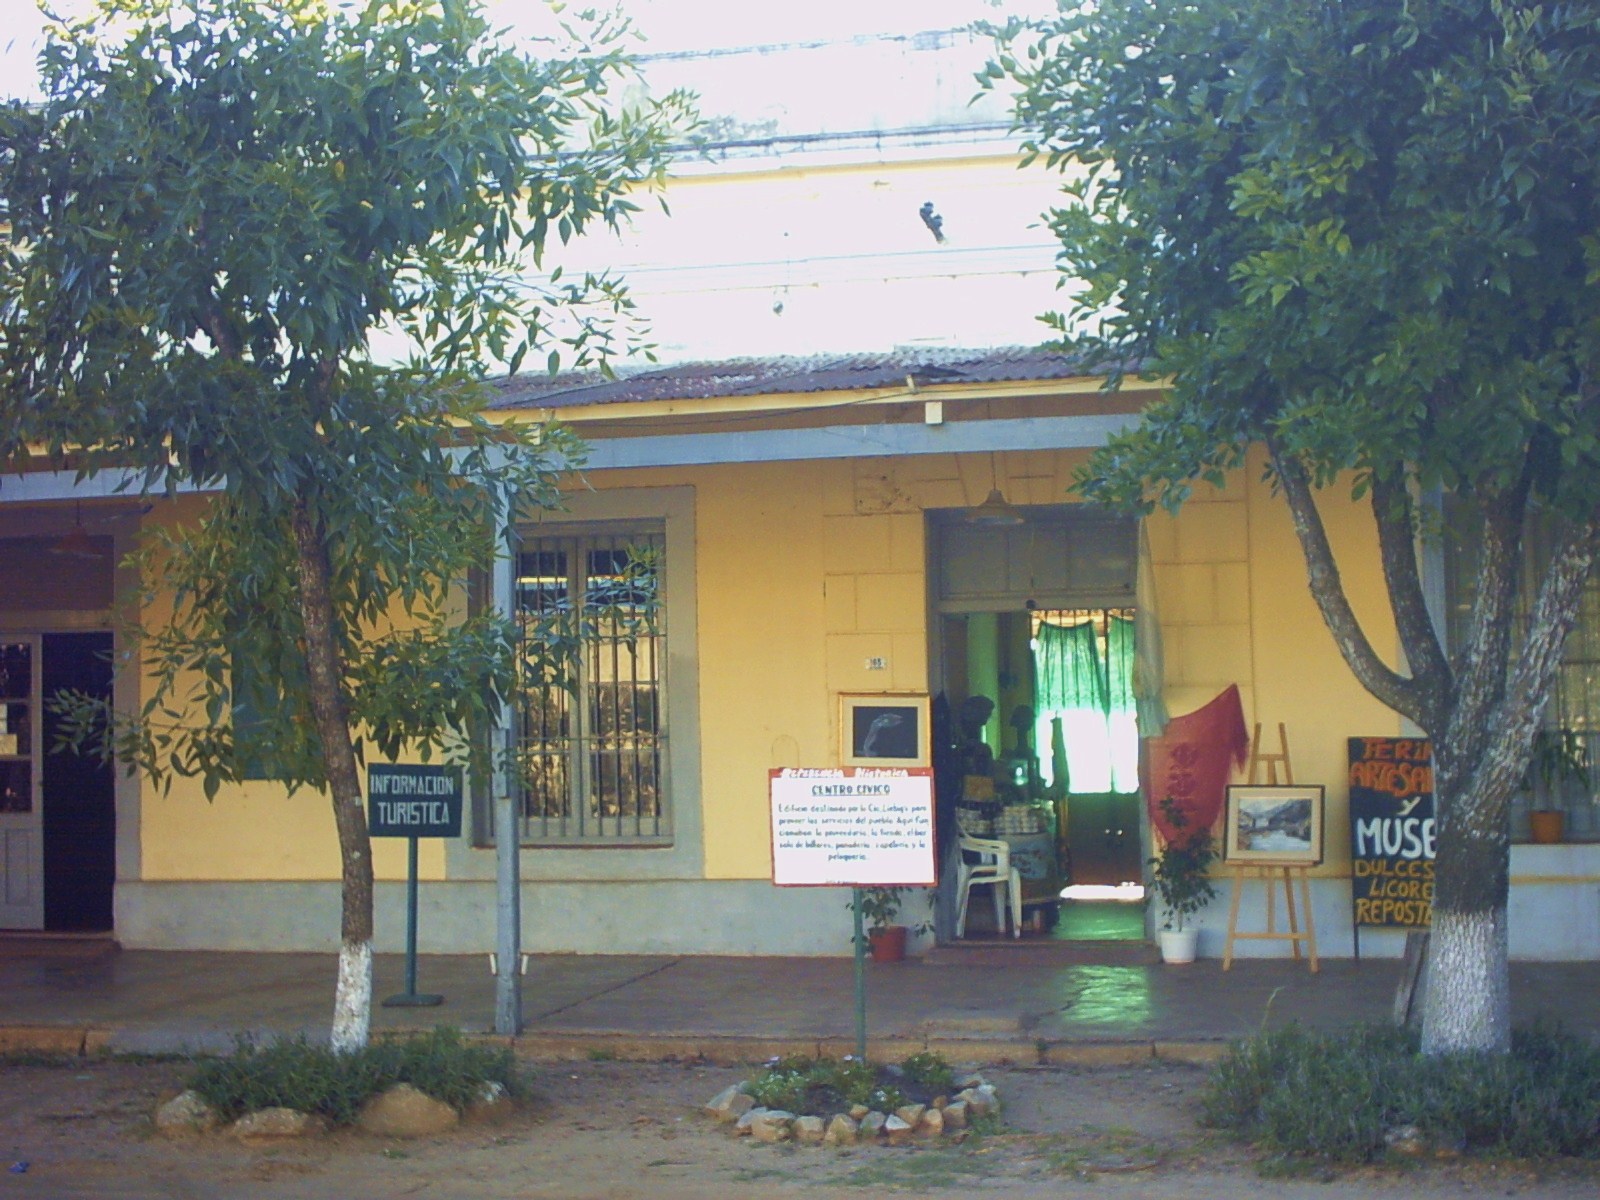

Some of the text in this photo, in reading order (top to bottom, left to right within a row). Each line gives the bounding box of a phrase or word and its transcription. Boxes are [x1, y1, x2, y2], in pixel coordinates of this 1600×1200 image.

[370, 774, 454, 795] INFORMACION
[811, 784, 854, 796] CENTRO
[378, 801, 450, 824] TURISTICA
[1355, 860, 1434, 879] DULCES
